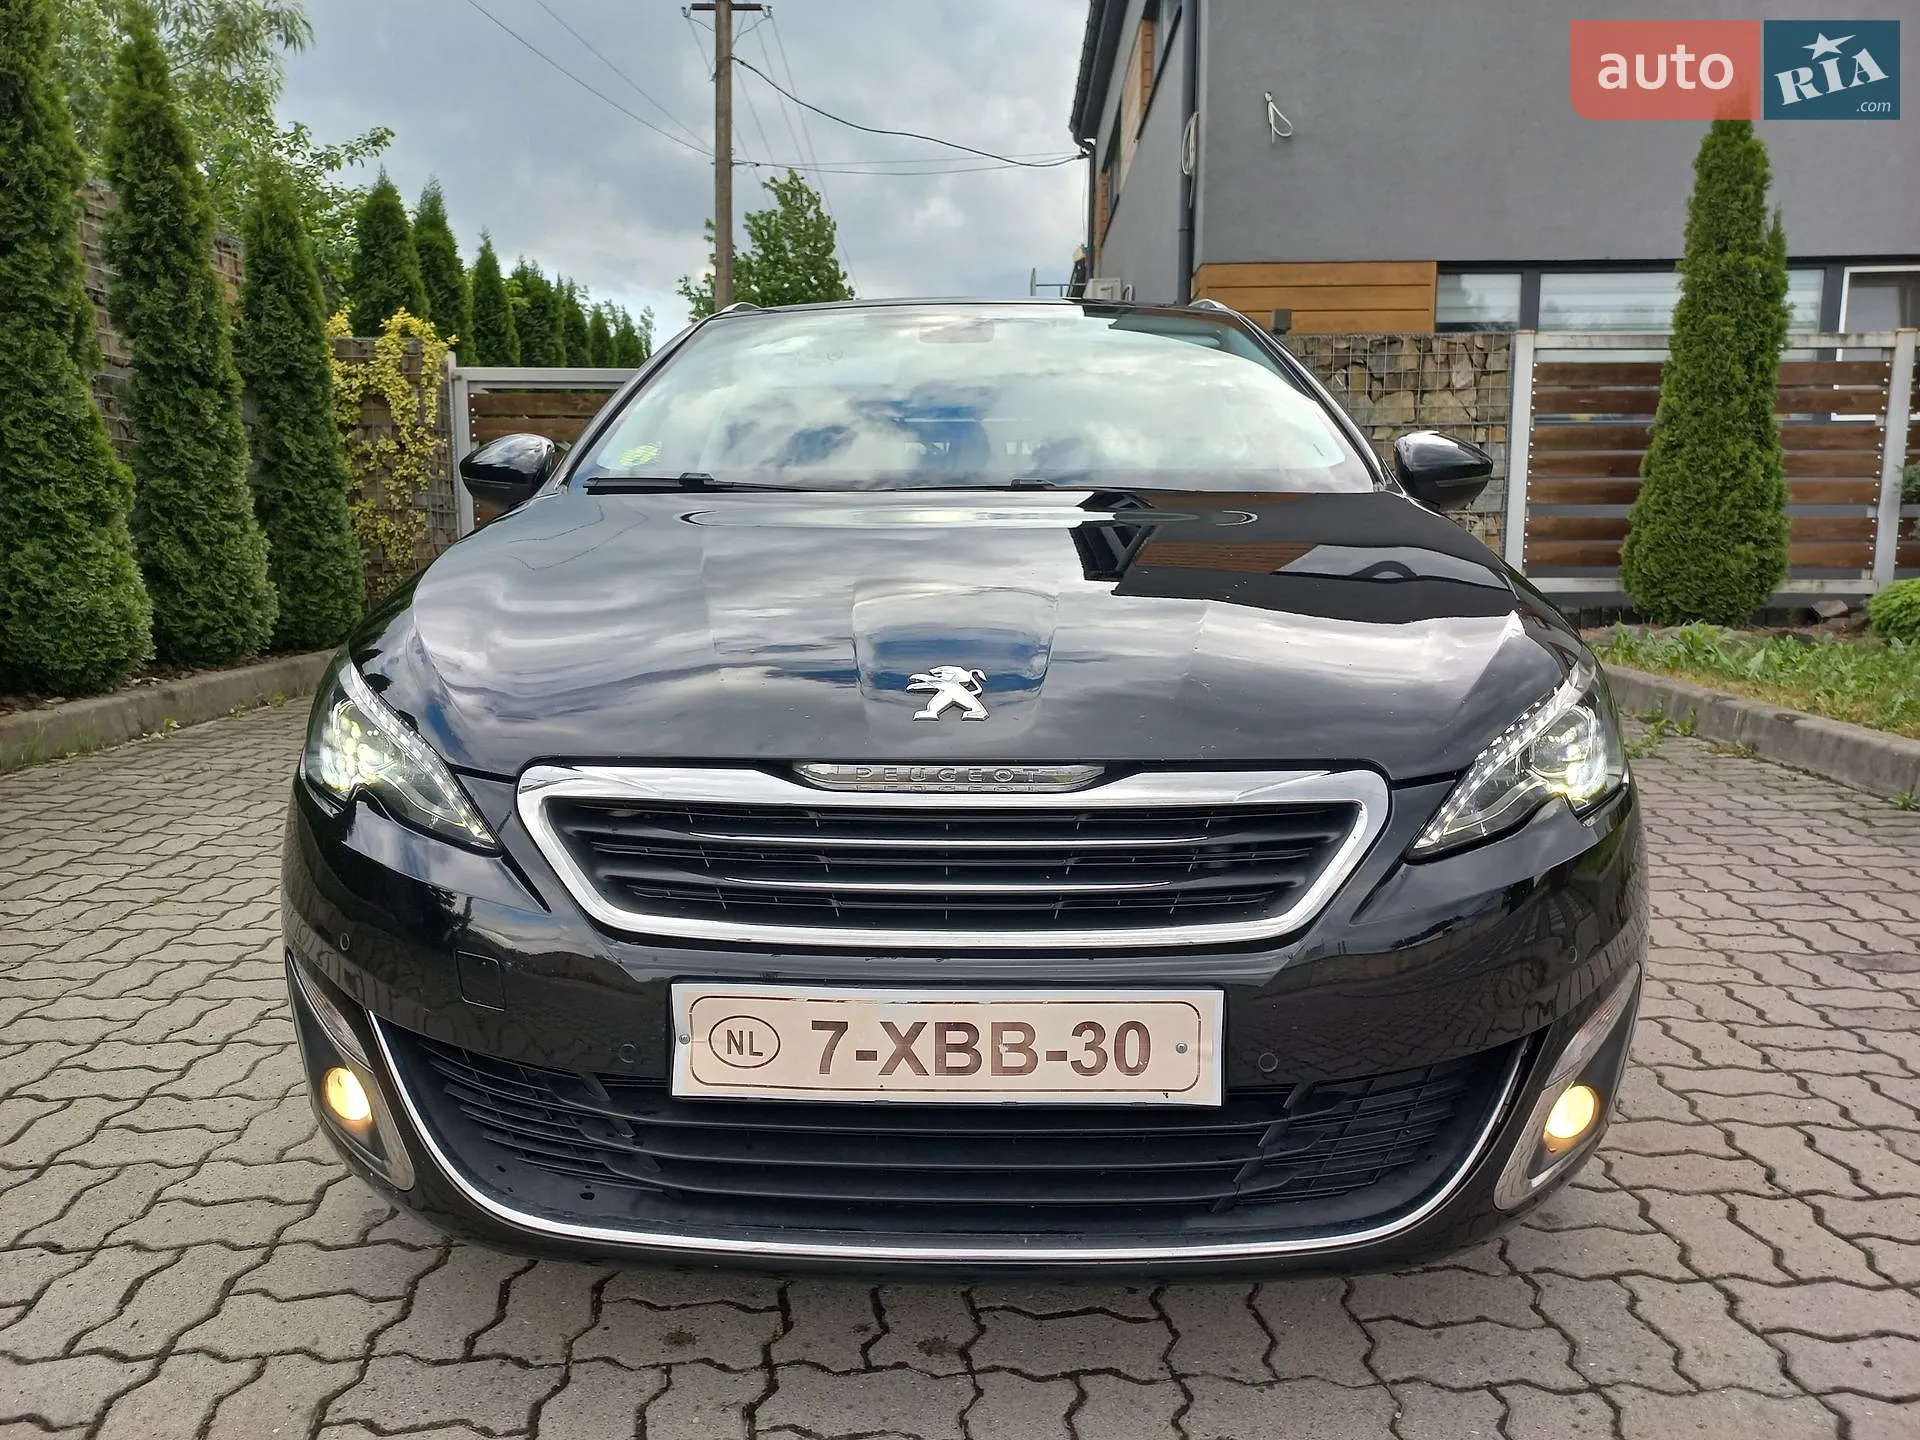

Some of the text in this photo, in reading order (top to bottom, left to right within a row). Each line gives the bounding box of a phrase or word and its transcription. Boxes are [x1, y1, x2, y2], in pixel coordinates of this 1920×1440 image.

[855, 767, 1041, 782] PEUGEOT
[725, 1029, 763, 1057] NL
[810, 1020, 1152, 1077] 7-XBB-30
